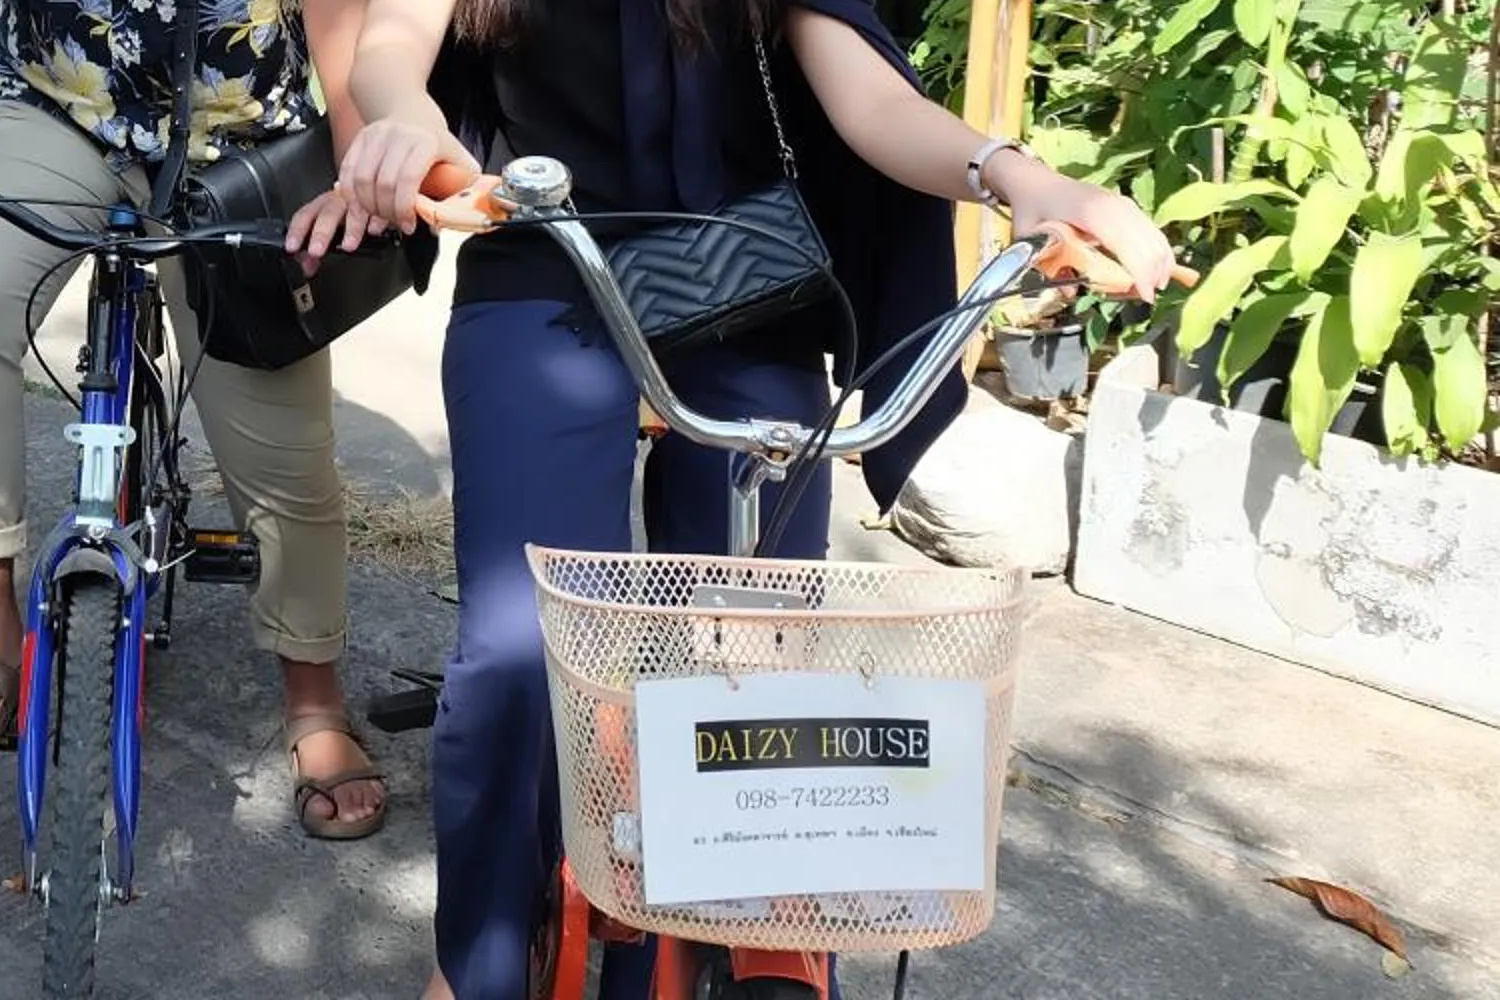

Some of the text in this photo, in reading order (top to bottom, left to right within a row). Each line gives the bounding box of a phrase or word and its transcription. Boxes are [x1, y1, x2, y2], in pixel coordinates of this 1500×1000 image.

[696, 726, 929, 763] DAIZY HOUSE
[735, 784, 891, 811] 098-7422233
